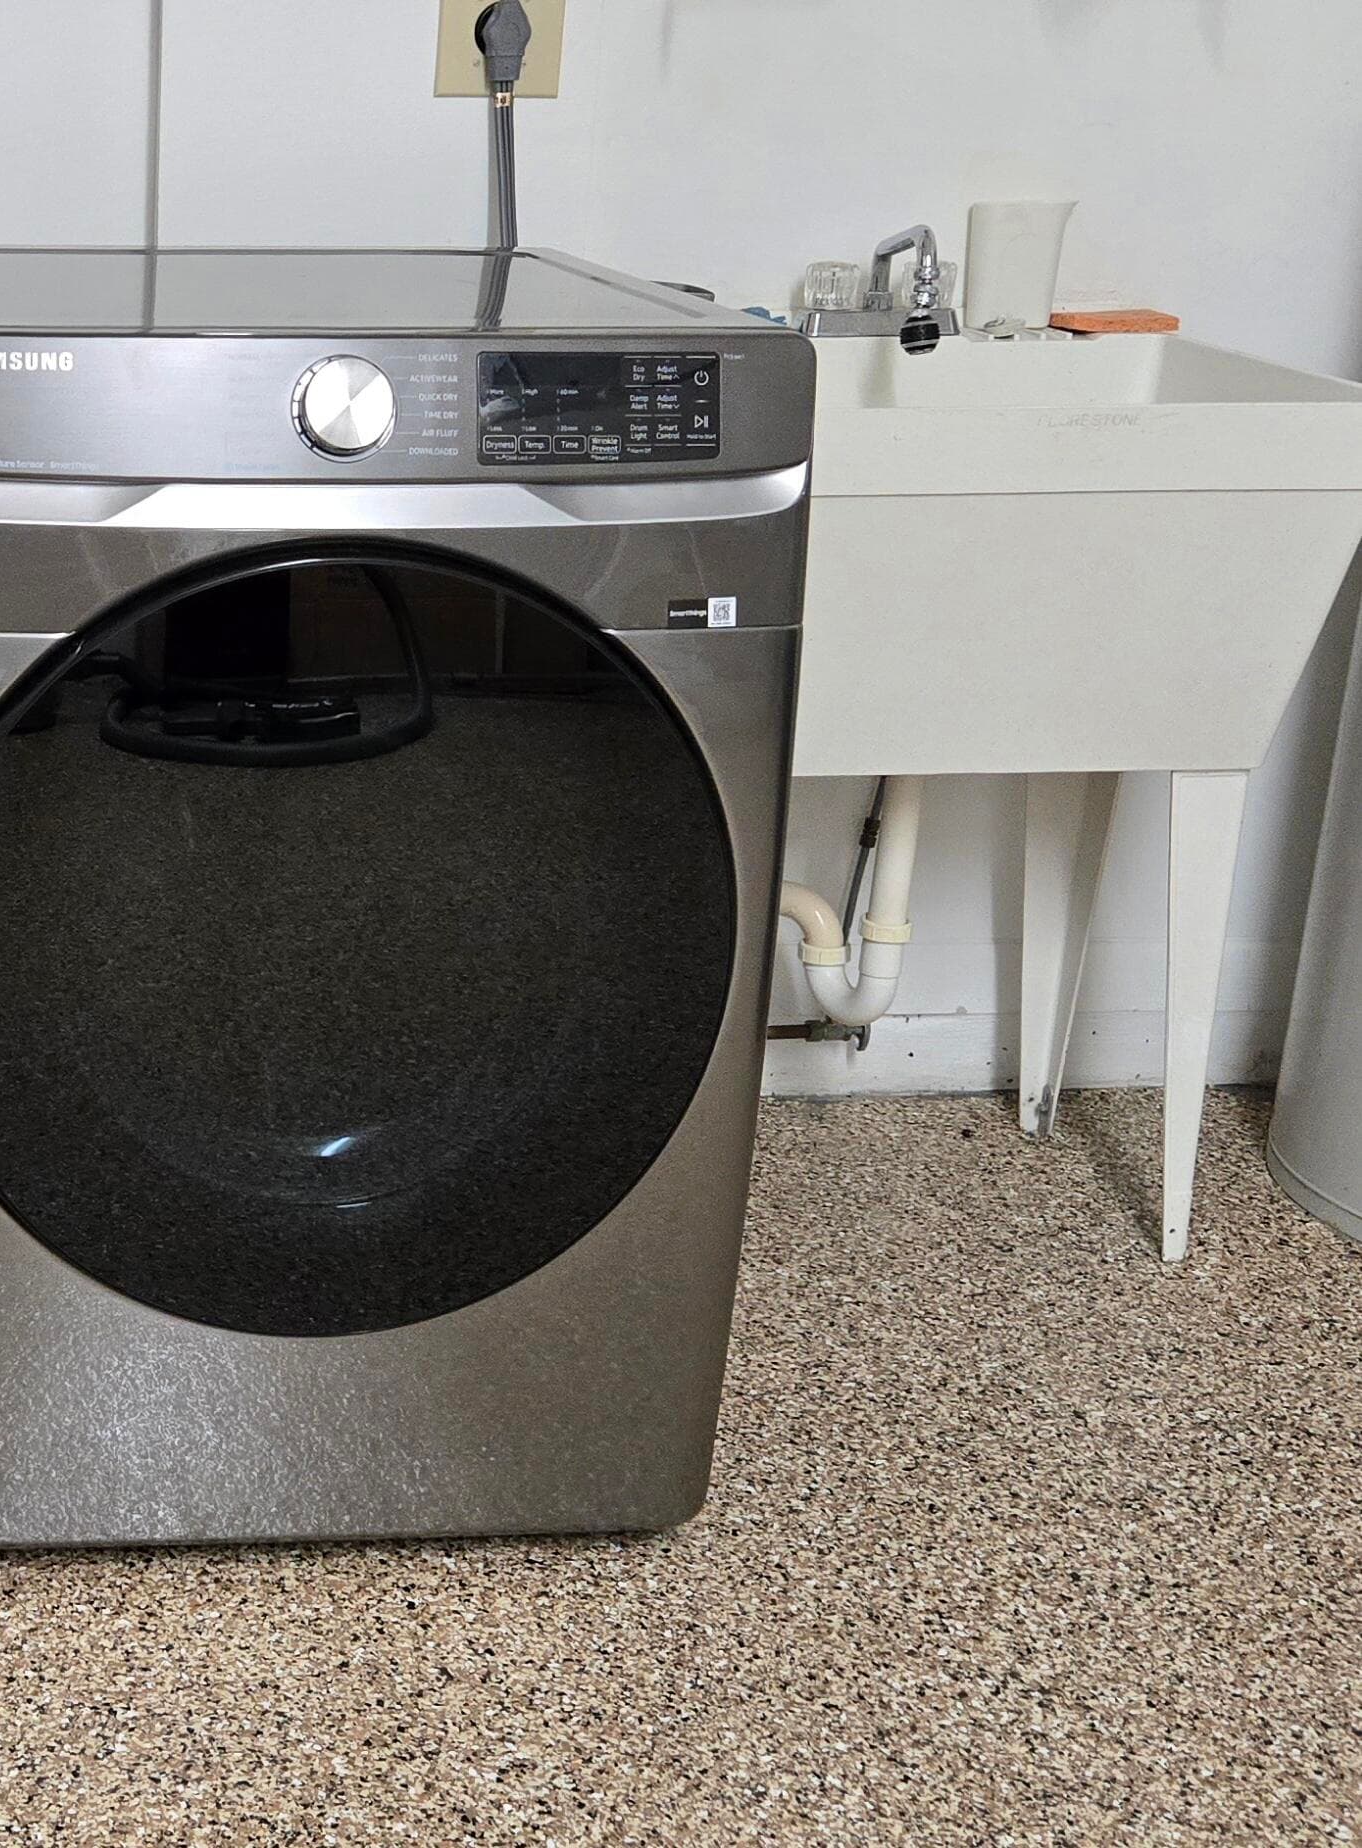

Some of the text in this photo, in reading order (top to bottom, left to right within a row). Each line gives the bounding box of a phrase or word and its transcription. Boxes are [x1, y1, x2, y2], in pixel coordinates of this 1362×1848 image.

[418, 352, 458, 362] DELICATES
[632, 365, 645, 373] Eco
[656, 365, 678, 373] Adjust
[409, 374, 459, 383] ACTIVEWEAR
[632, 373, 645, 381] Dry
[657, 373, 672, 381] Time
[418, 392, 458, 402] QUICK DRY
[630, 402, 648, 410] Alert
[657, 402, 672, 410] Time
[630, 424, 648, 432] Drum
[658, 424, 679, 432] Smart
[421, 428, 459, 438] AIR FLUFF
[630, 432, 648, 441] Light
[656, 431, 680, 440] Control
[486, 440, 514, 450] Dryness
[561, 440, 579, 449] Time
[591, 444, 619, 452] Prevent
[408, 446, 459, 457] DOWNLOADED
